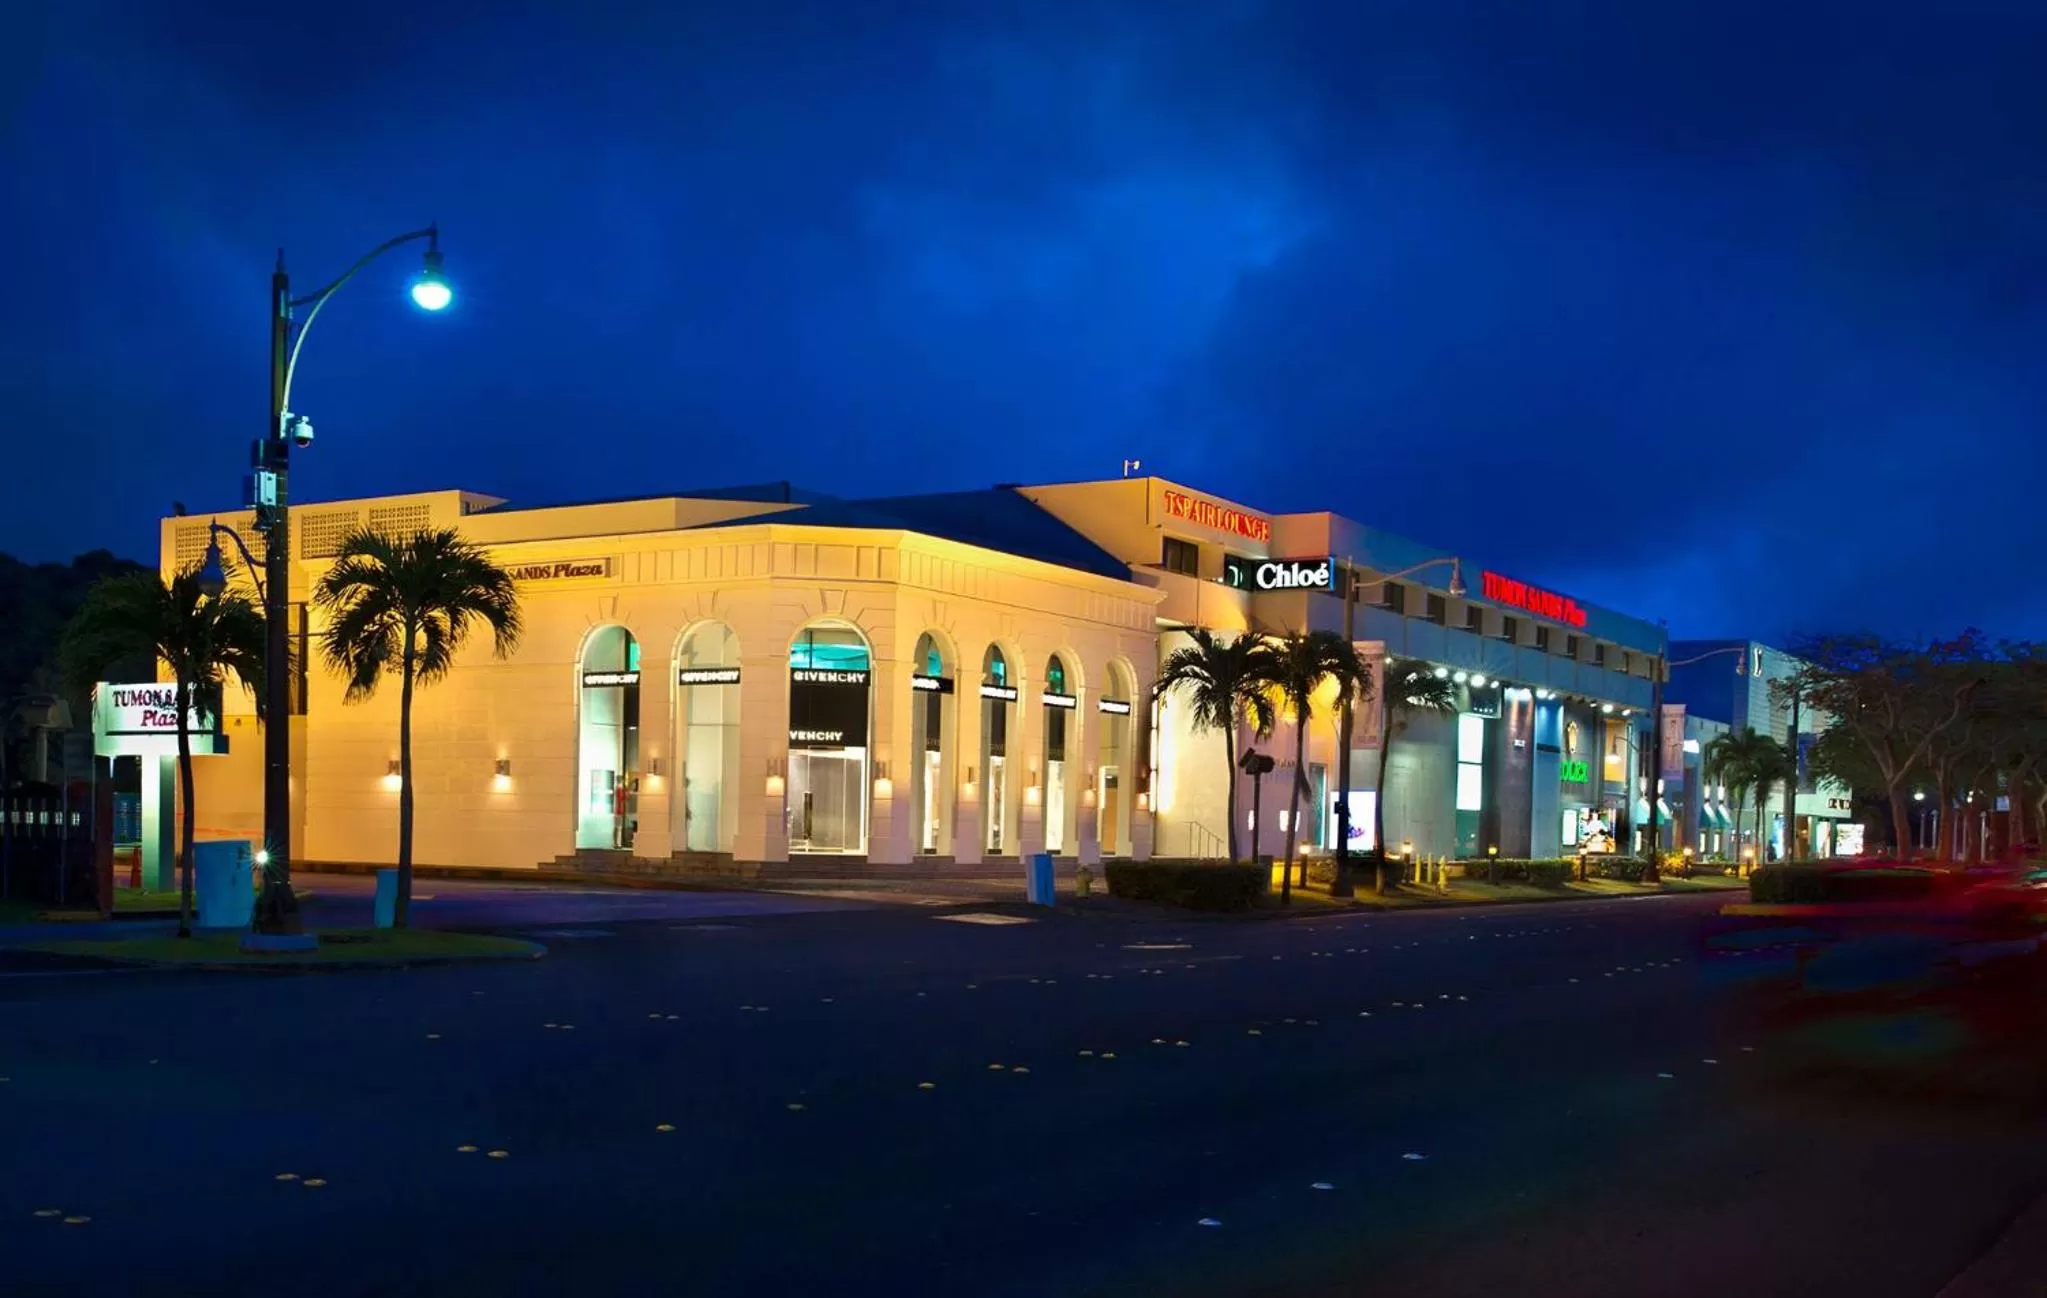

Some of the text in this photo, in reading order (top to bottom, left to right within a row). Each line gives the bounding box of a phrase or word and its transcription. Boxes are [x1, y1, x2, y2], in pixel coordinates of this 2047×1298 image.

[552, 563, 602, 578] Plaza
[1256, 562, 1329, 589] Chloé
[793, 671, 866, 684] GIVENCHY
[113, 690, 163, 708] TUMON
[141, 709, 179, 727] Plaz
[789, 730, 843, 741] VENCHY
